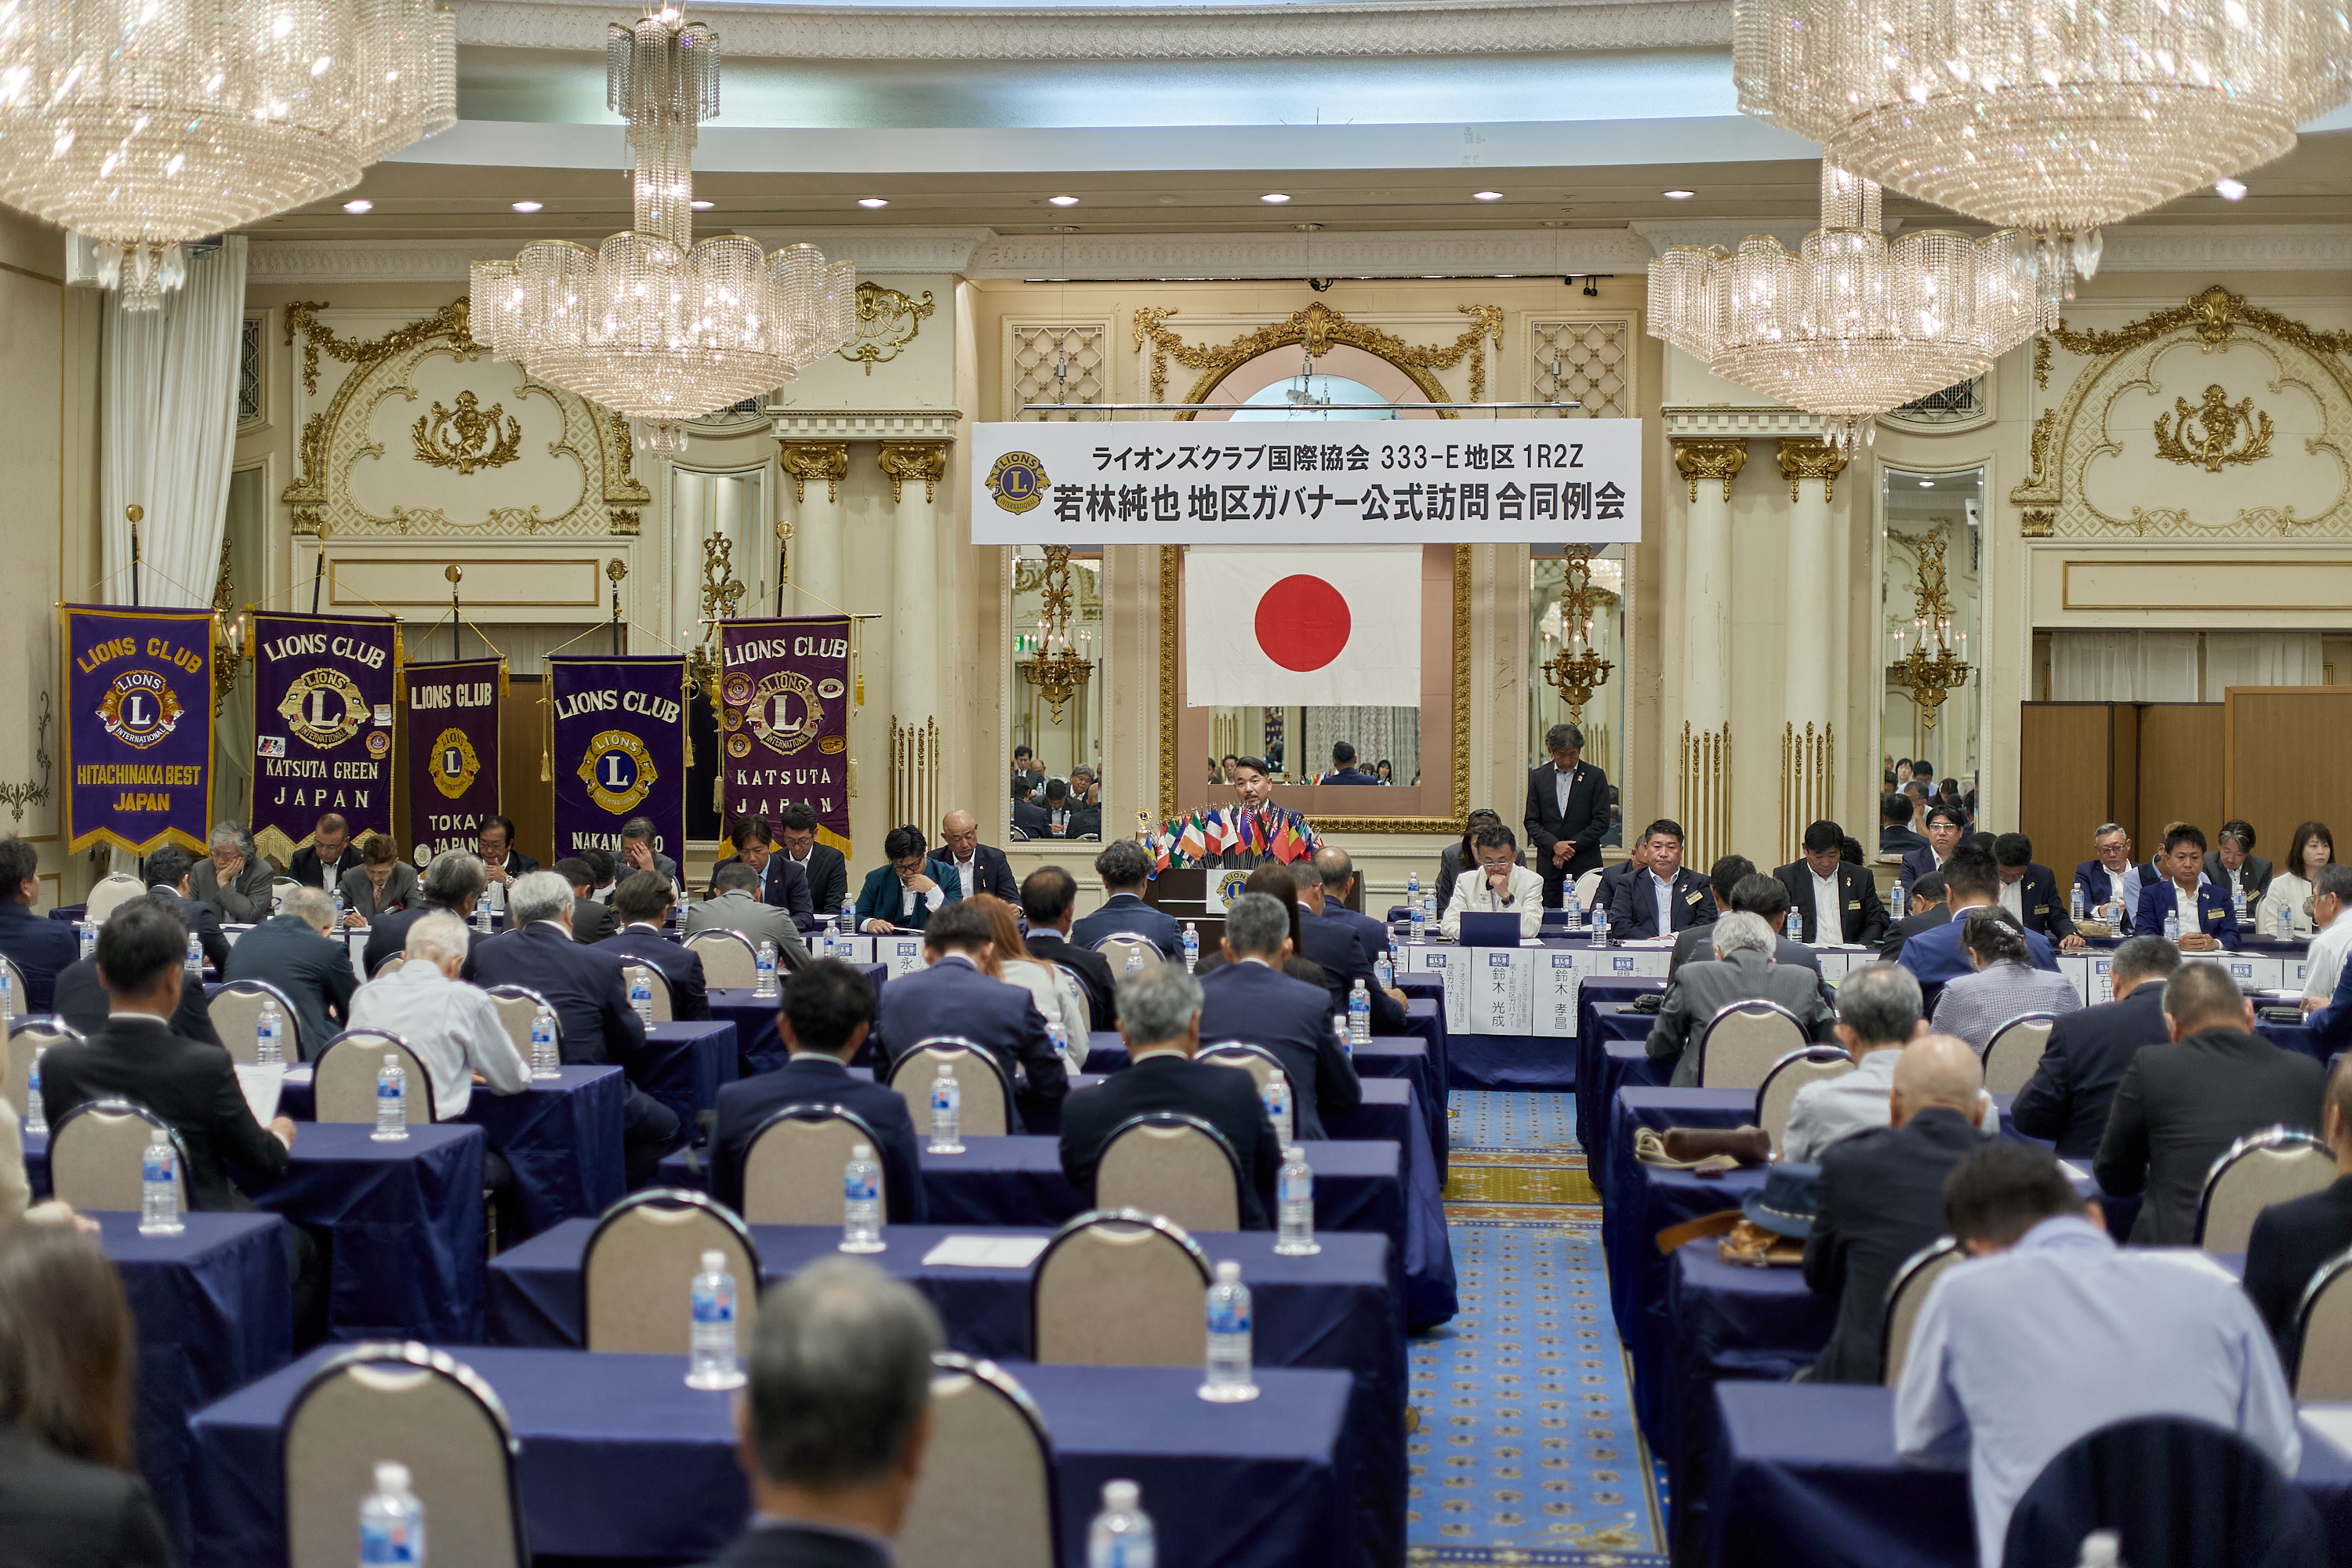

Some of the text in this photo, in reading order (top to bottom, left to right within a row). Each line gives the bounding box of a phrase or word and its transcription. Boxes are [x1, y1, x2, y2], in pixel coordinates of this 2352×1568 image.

[1000, 454, 1036, 468] LIONS
[1092, 444, 1370, 471] ライオンズクラブ国際協会
[1523, 444, 1584, 469] 1R2Z
[1011, 471, 1027, 492] L
[1000, 499, 1036, 510] INTERNATIONAL
[1054, 483, 1181, 523] 若林純也
[76, 637, 202, 673] LIONS CLUB
[263, 633, 386, 670] LIONS CLUB
[724, 636, 848, 667] LIONS CLUB
[118, 674, 162, 691] LIONS
[305, 672, 347, 689] LIONS
[764, 675, 807, 694] LIONS
[412, 682, 492, 710] LIONS CLUB
[554, 689, 681, 723] LIONS CLUB
[130, 696, 151, 724] L
[310, 690, 342, 727] L
[773, 695, 803, 731] L
[116, 727, 165, 743] INTERNATIONAL
[300, 725, 347, 743] INTERNATIONAL
[441, 732, 465, 746] LIONS
[596, 735, 638, 752] LIONS
[765, 733, 808, 749] INTERNATIONAL
[266, 758, 379, 779] KATSUTA GREEN
[445, 750, 461, 774] L
[606, 756, 628, 786] L
[77, 764, 201, 786] HITACHINAKA BEST
[737, 768, 831, 786] KATSUTA
[113, 793, 169, 811] JAPAN
[274, 786, 369, 808] JAPAN
[594, 790, 641, 806] INTERNATIONAL
[1492, 967, 1505, 1027] 鈴木 光成
[1555, 969, 1568, 1029] 鈴木 孝昌
[2100, 976, 2114, 1002] 石井
